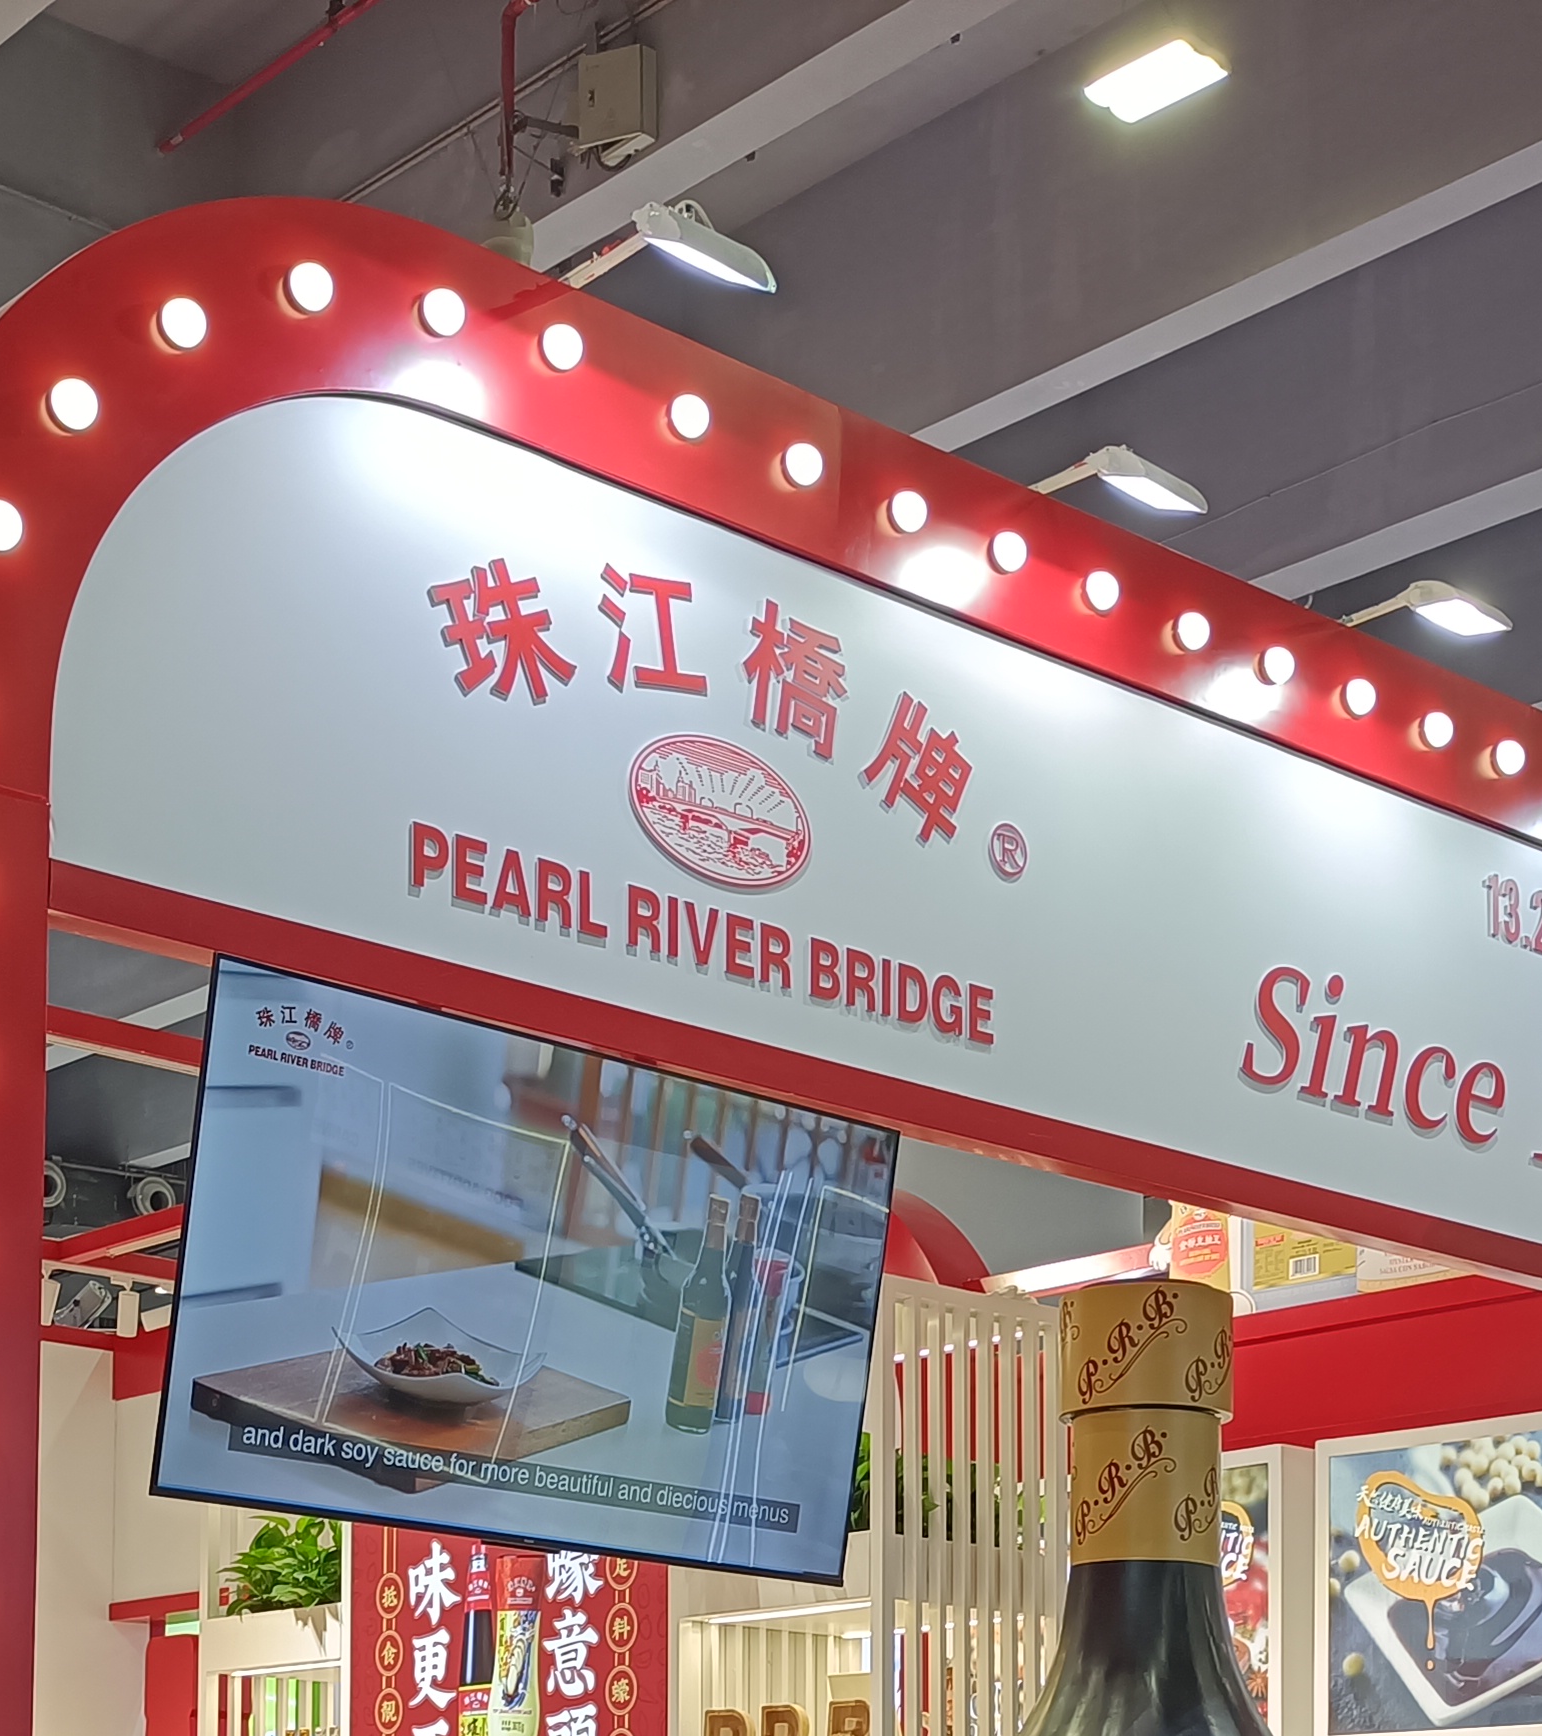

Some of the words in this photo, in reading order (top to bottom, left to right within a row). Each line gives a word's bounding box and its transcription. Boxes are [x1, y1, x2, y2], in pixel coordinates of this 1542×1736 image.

[428, 558, 973, 846] 珠江橋牌
[408, 820, 608, 946] PEARL
[625, 883, 792, 995] RIVER
[809, 938, 995, 1046] BRIDGE
[248, 1044, 279, 1062] PEARL
[279, 1052, 309, 1069] RIVER
[309, 1059, 345, 1077] BRIDGE
[255, 1005, 344, 1046] 珠江橋牌
[1239, 965, 1507, 1147] Since
[242, 1425, 285, 1450] and
[289, 1428, 337, 1457] dark
[341, 1441, 379, 1469] soy
[383, 1447, 445, 1472] sauce
[449, 1453, 476, 1477] for
[479, 1461, 530, 1486] more
[534, 1465, 614, 1499] beautiful
[618, 1483, 653, 1503] and
[656, 1484, 728, 1515] diecious
[733, 1498, 790, 1524] menus
[1354, 1514, 1485, 1560] AUTHENTIC
[1381, 1547, 1476, 1591] SAUCE
